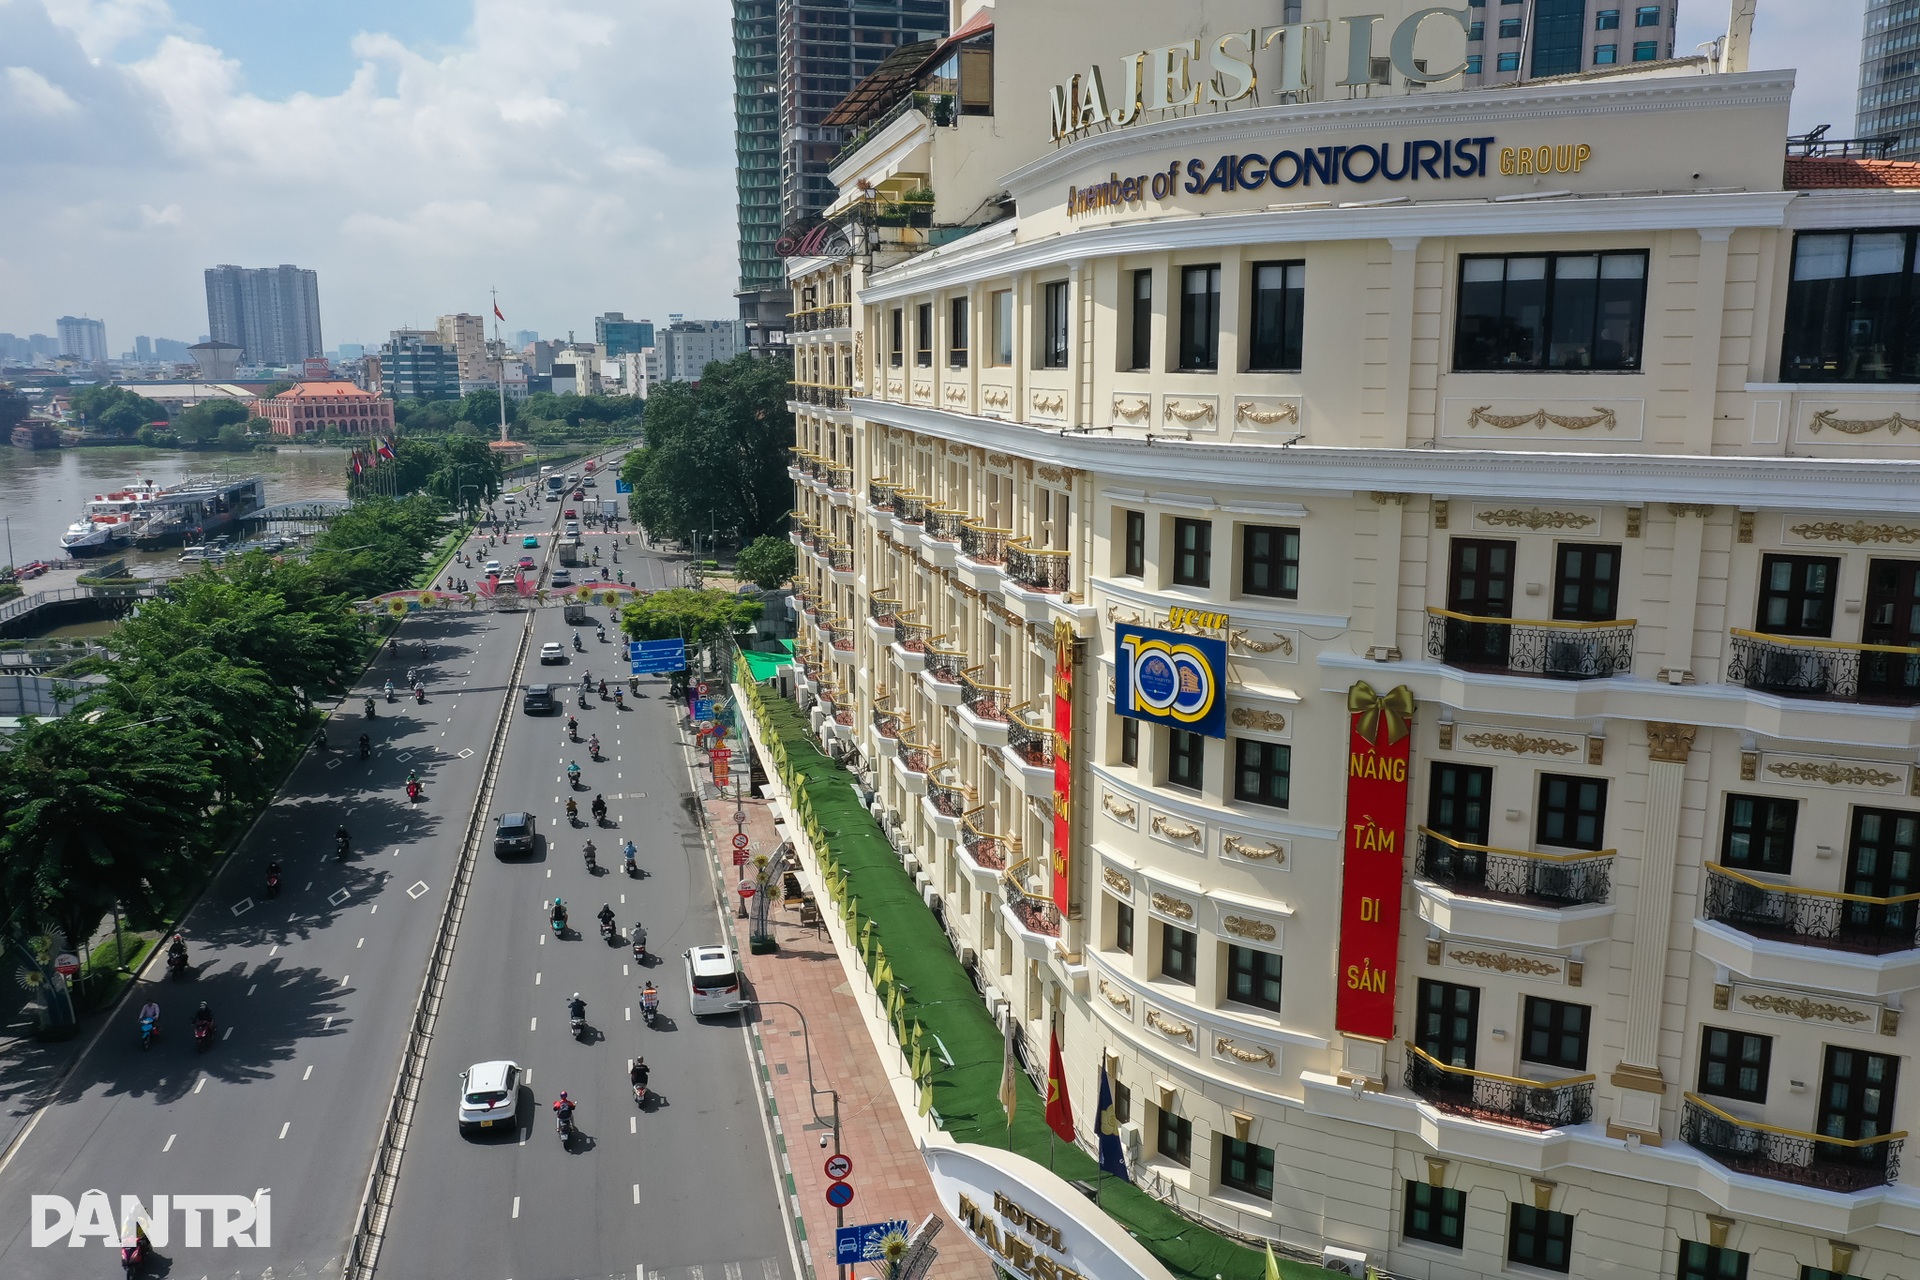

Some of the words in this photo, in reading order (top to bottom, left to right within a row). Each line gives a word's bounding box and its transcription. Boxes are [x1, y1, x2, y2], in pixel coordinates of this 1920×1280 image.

[1048, 5, 1473, 144] MAJESTIC
[1066, 185, 1077, 217] A
[1077, 172, 1148, 211] member
[1151, 160, 1181, 200] of
[1184, 136, 1495, 194] SAIGONTOURIST
[1499, 143, 1591, 176] GROUP
[1168, 605, 1229, 630] year
[1120, 633, 1215, 723] 100
[1350, 748, 1406, 782] NÂNG
[1353, 814, 1396, 853] TẦM
[1360, 896, 1380, 923] DI
[1347, 957, 1387, 994] SẢN
[958, 1191, 1090, 1280] MAJES
[993, 1189, 1067, 1255] HOTEL
